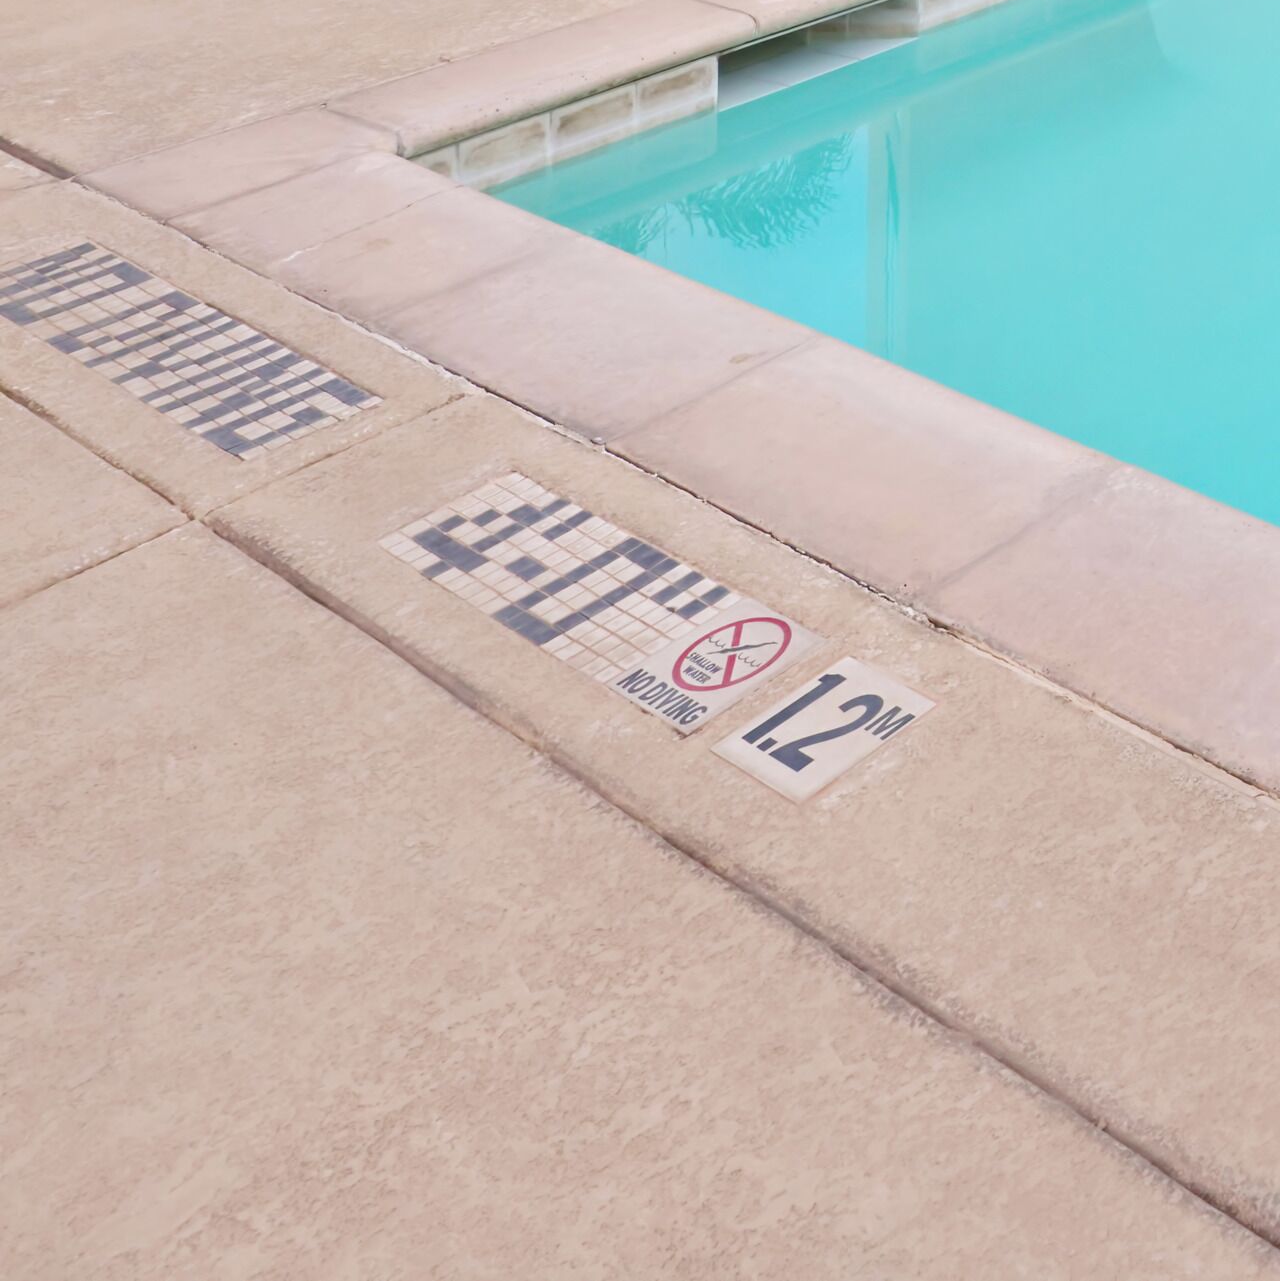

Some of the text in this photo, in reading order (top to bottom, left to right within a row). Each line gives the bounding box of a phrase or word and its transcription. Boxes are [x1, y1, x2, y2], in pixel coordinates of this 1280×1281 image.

[685, 652, 722, 674] SHALLOW
[683, 665, 712, 684] WATER
[616, 668, 708, 726] NO DIVING
